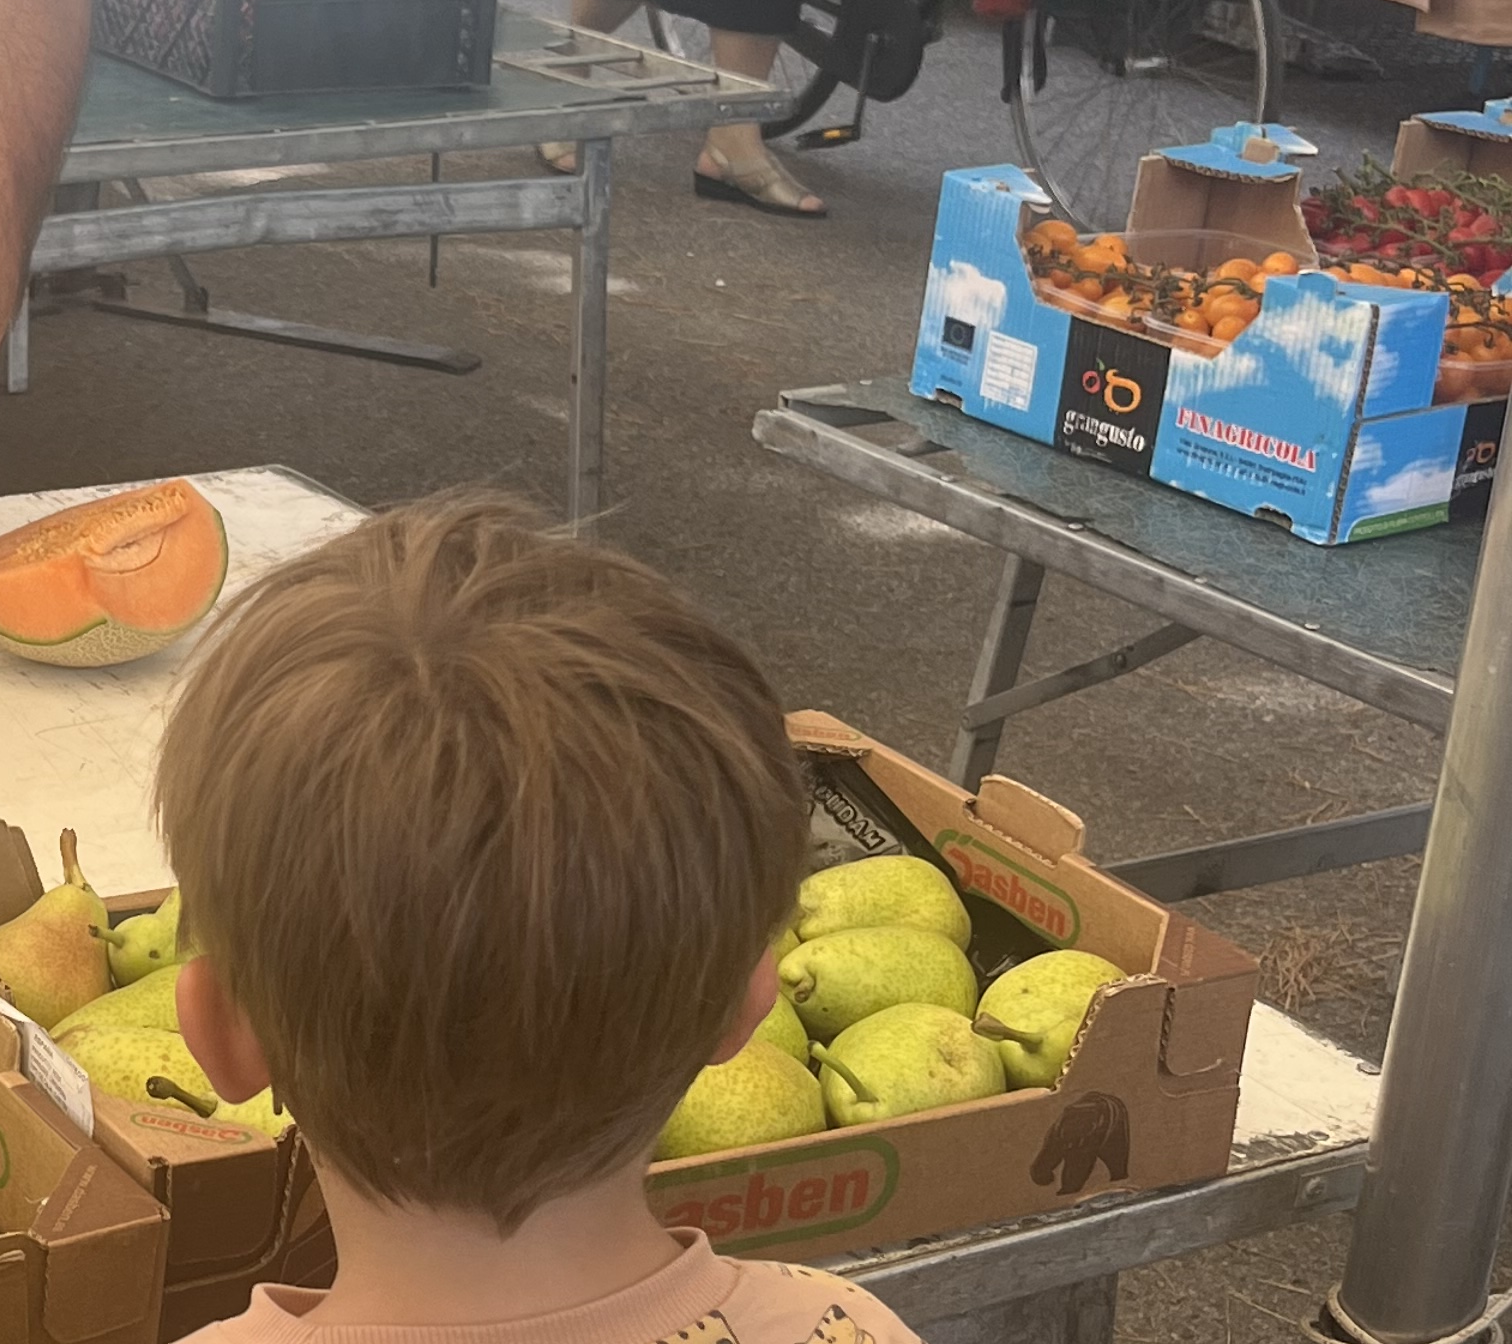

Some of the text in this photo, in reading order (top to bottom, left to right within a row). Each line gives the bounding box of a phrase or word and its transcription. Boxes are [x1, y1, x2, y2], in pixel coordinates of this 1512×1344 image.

[1063, 410, 1146, 453] grangusto
[1176, 406, 1317, 471] FINAGRICOLA
[664, 1169, 870, 1236] asben
